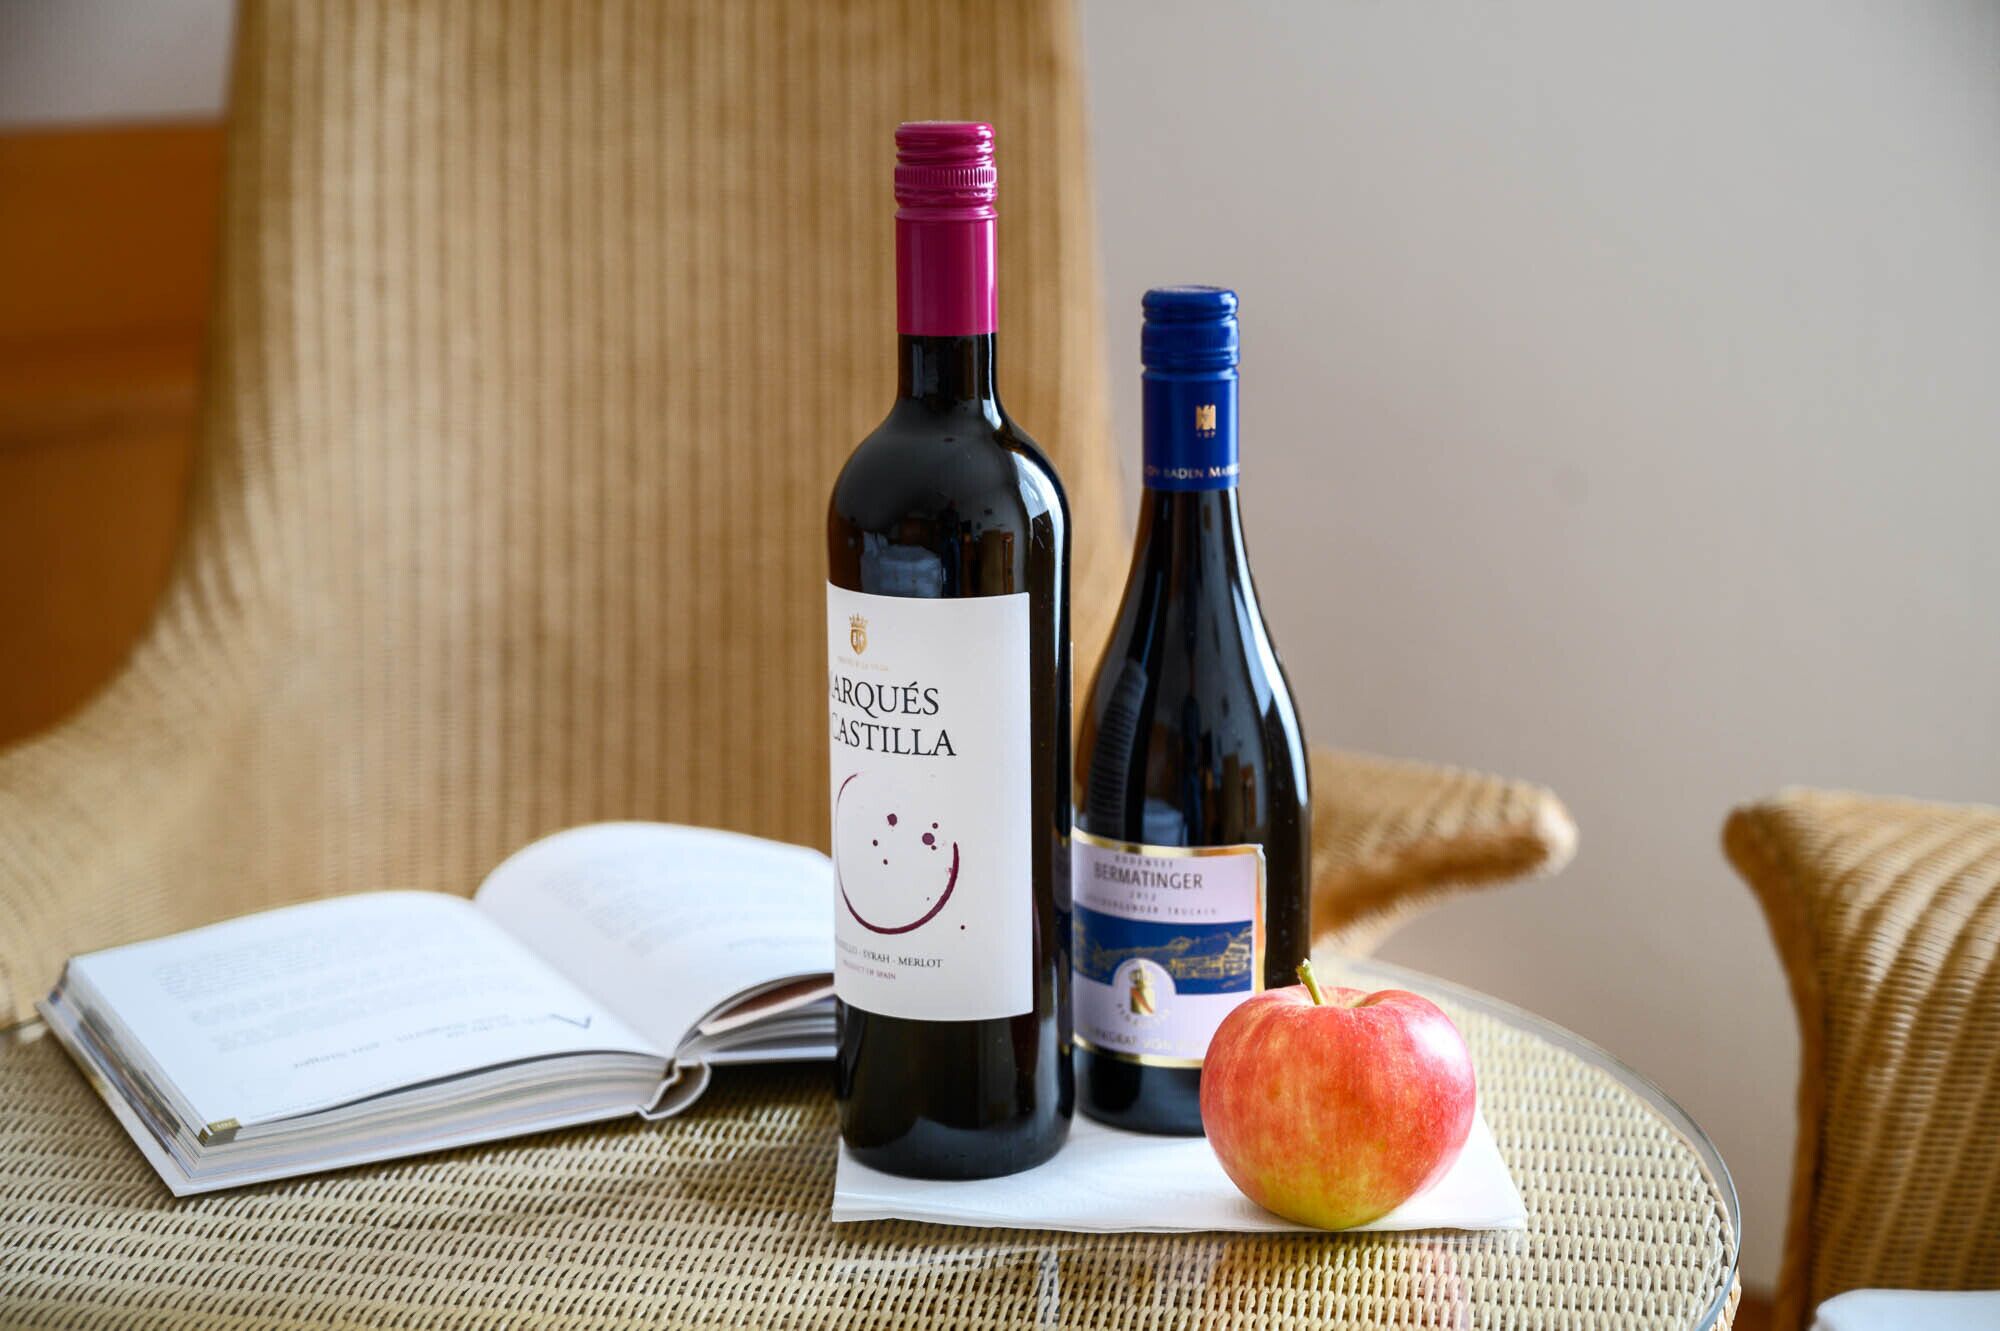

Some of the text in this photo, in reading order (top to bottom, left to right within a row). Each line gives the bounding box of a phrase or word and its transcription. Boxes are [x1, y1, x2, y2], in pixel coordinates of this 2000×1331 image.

[832, 674, 939, 718] ARQUÉS
[1093, 861, 1203, 890] BERMATINGER
[898, 956, 943, 968] MERLOT
